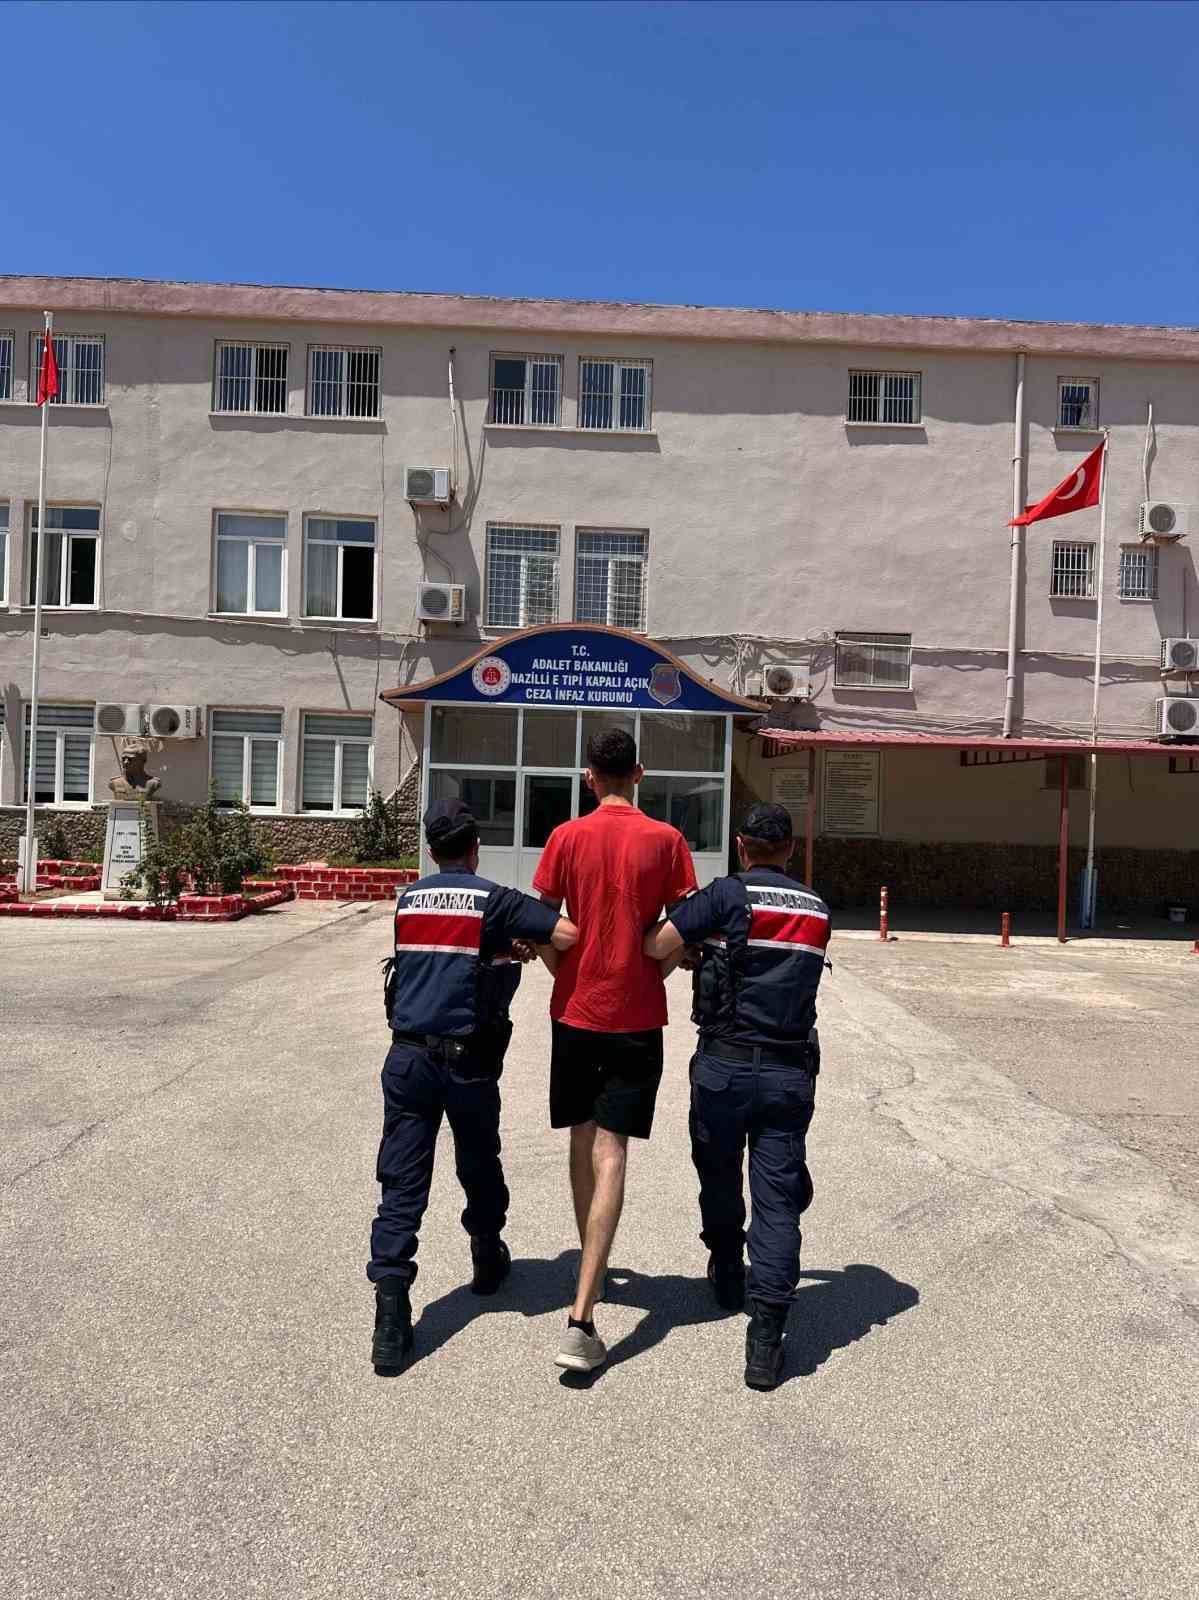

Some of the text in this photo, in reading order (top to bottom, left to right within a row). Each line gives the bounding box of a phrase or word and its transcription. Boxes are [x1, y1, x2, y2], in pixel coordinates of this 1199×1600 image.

[571, 645, 590, 656] T.C.
[532, 658, 629, 673] ADALET BAKANLIĞI
[511, 671, 549, 685] NAZİLLİ
[553, 675, 559, 685] E
[586, 675, 621, 688] KAPALI
[624, 677, 649, 691] AÇIK
[526, 687, 633, 703] CEZA İNFAZ KURUMU
[408, 892, 475, 911] JANDARMA
